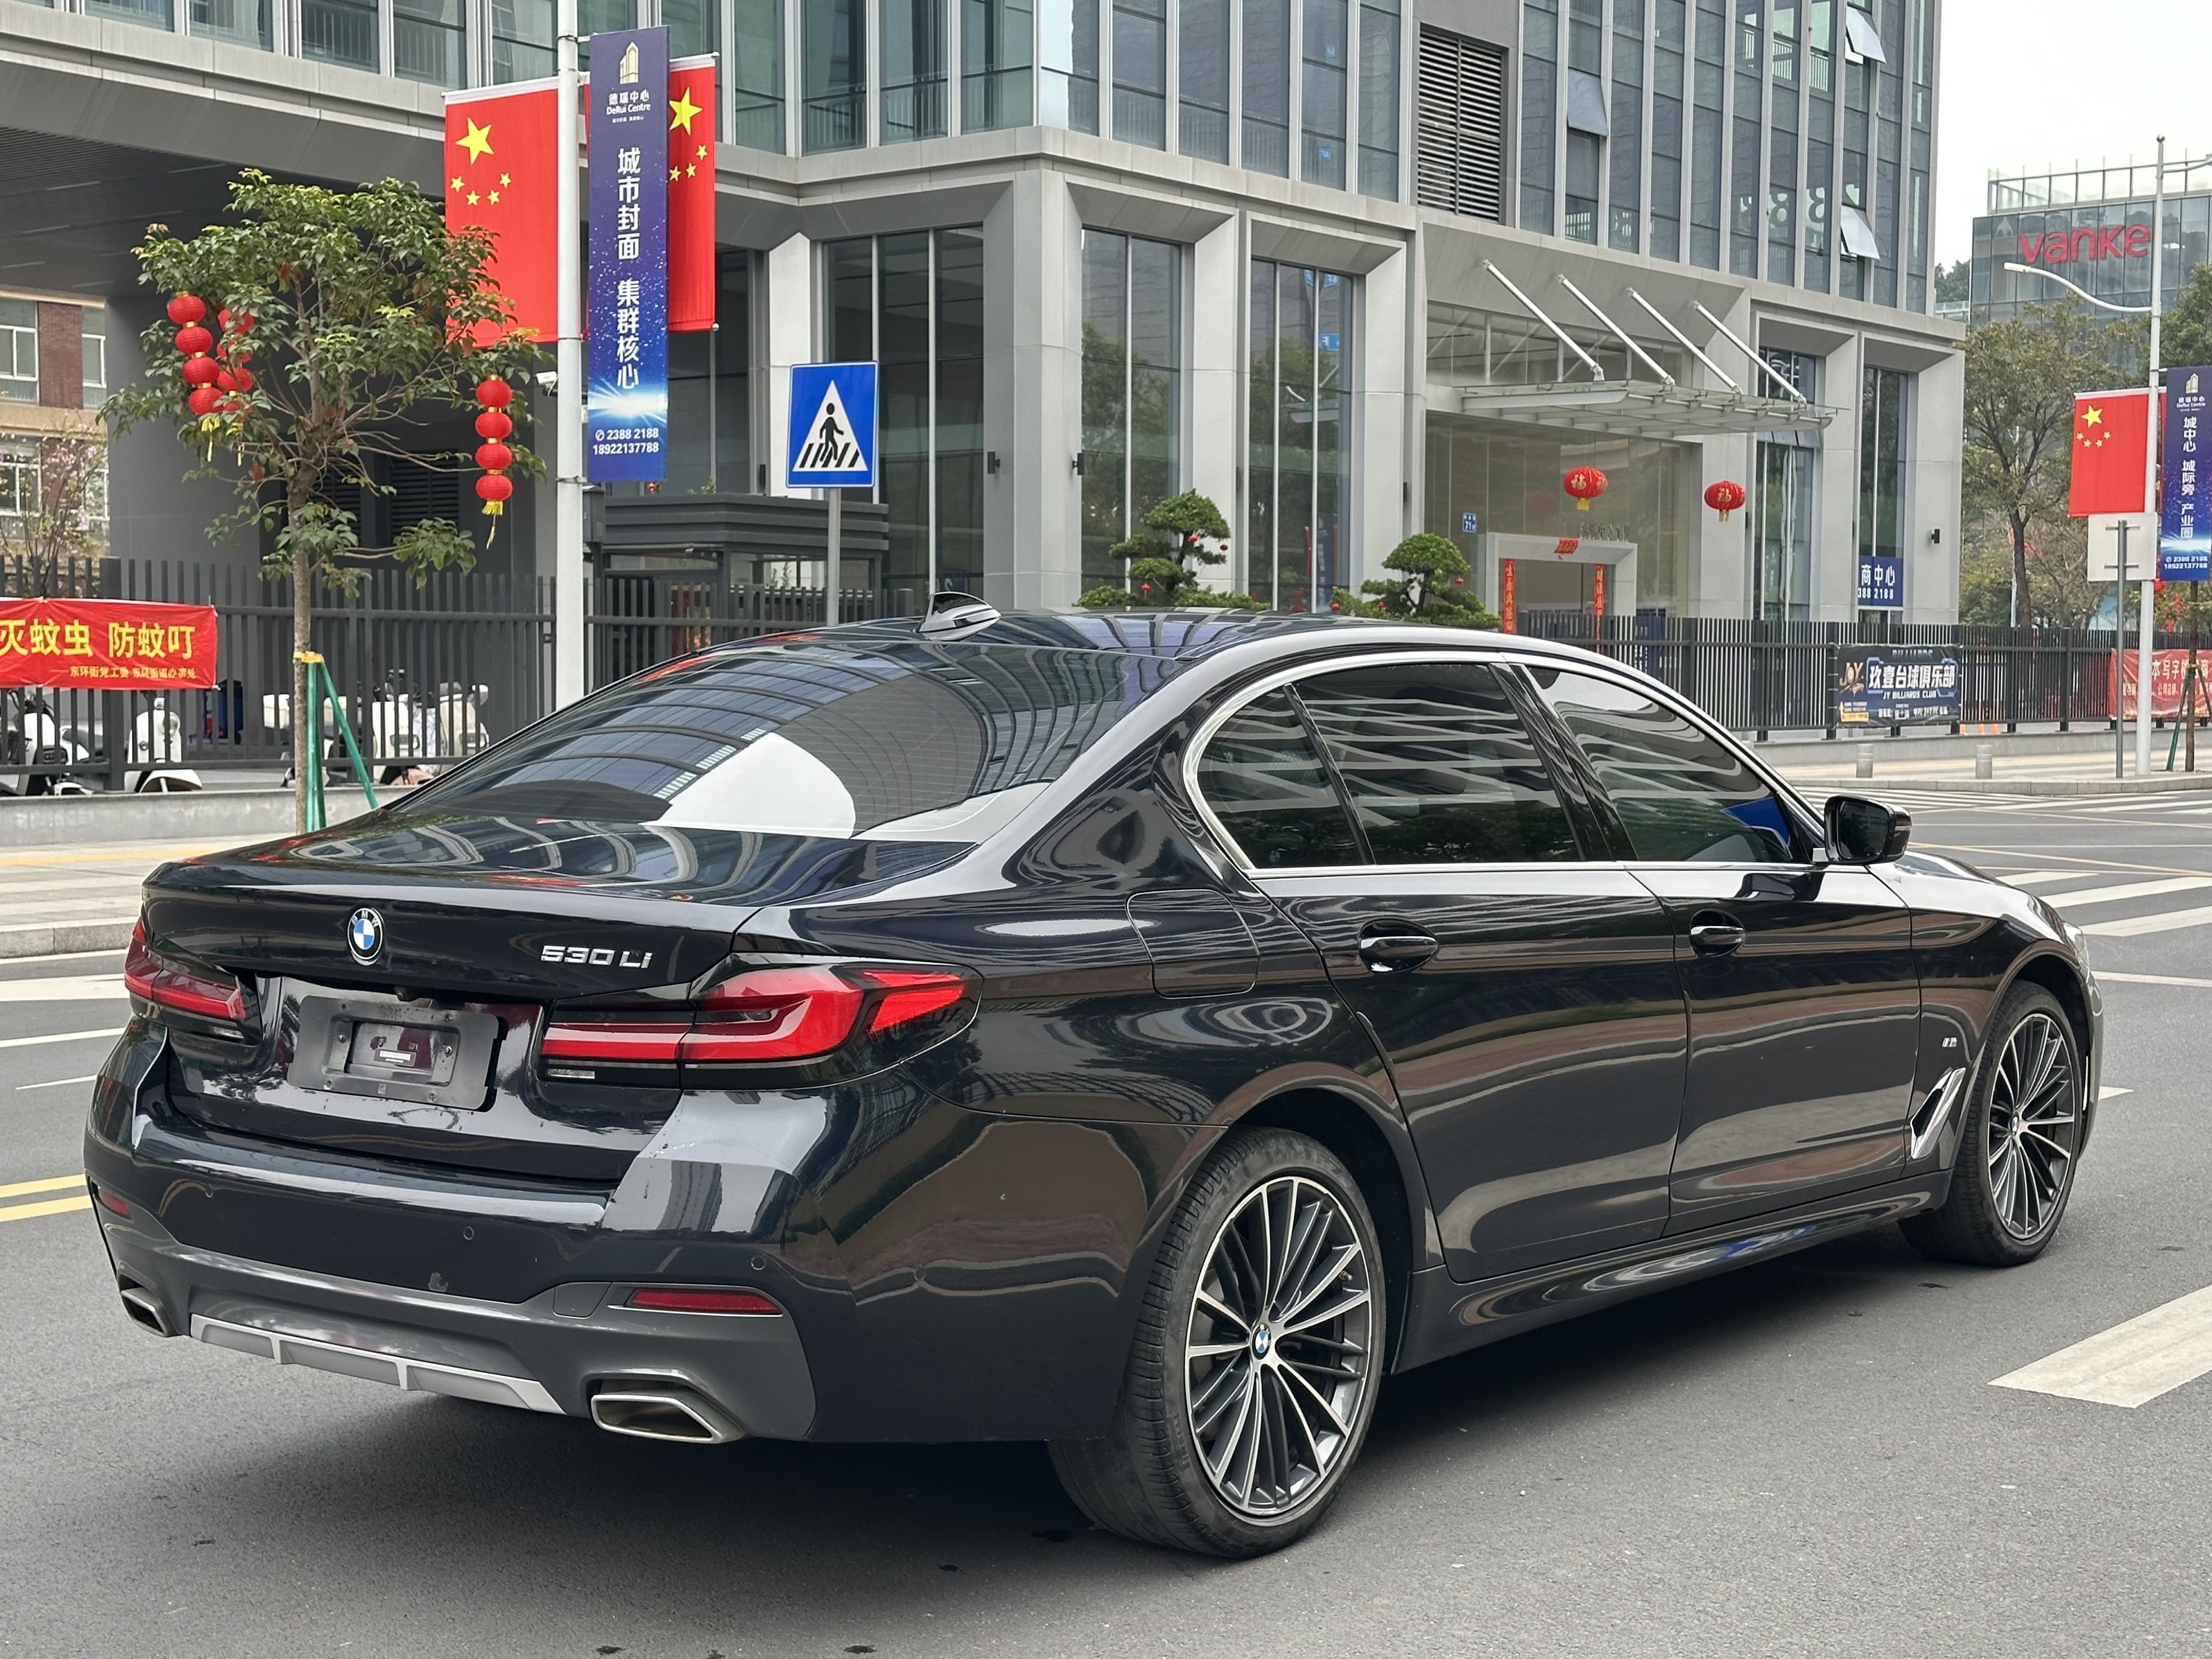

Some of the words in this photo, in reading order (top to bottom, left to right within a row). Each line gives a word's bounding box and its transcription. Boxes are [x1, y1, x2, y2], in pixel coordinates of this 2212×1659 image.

[606, 104, 627, 115] DeRui
[628, 103, 651, 112] Centre
[618, 147, 641, 259] 城市封面
[2019, 224, 2151, 264] vanke
[617, 279, 640, 389] 集群核心
[607, 429, 631, 441] 2388
[634, 427, 659, 439] 2188
[2183, 416, 2197, 453] 城中心
[592, 442, 659, 455] 18922137788
[1861, 564, 1895, 586] 商中心
[1874, 588, 1894, 599] 2188
[0, 618, 93, 658] 灭蚊虫
[108, 620, 195, 660] 防蚊叮
[1869, 664, 1955, 689] 玖壹台球俱乐部
[1883, 691, 1891, 699] JY
[352, 910, 380, 927] BMW
[541, 945, 615, 966] 530
